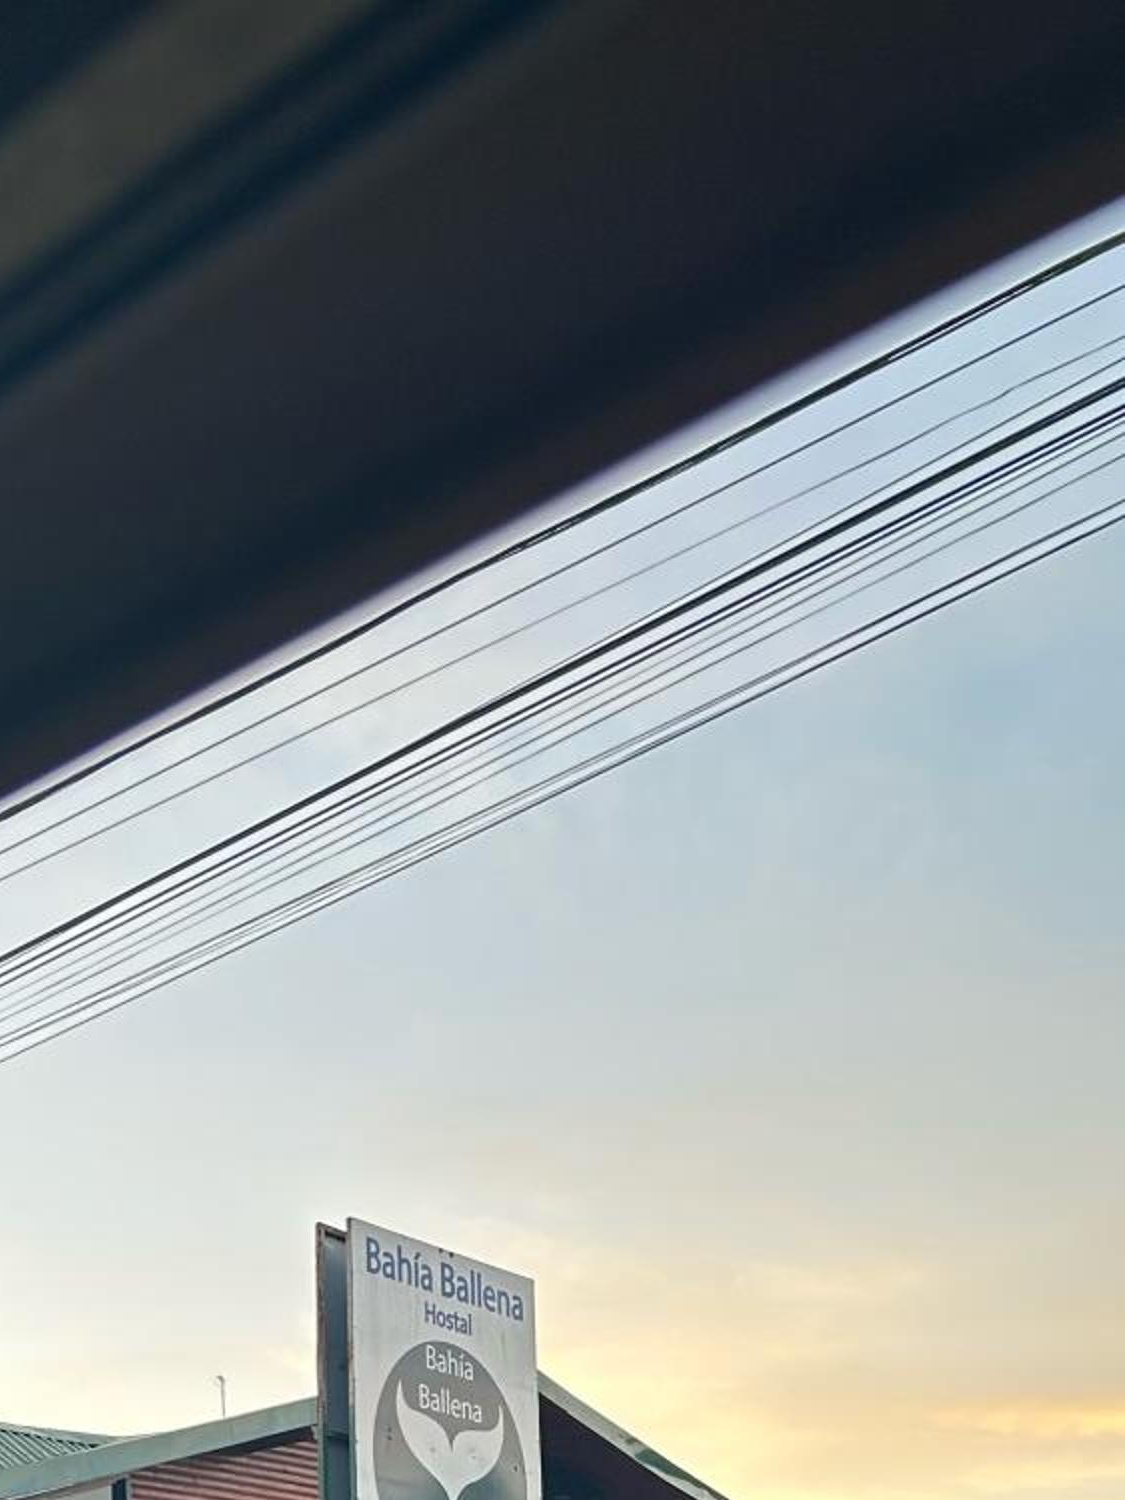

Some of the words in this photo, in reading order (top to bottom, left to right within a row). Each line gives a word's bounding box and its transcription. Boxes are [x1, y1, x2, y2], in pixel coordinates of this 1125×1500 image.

[366, 1237, 433, 1293] Bahía
[440, 1262, 524, 1321] Ballena
[424, 1302, 473, 1336] Hostal
[426, 1344, 474, 1381] Bahía
[418, 1383, 483, 1423] Ballena
